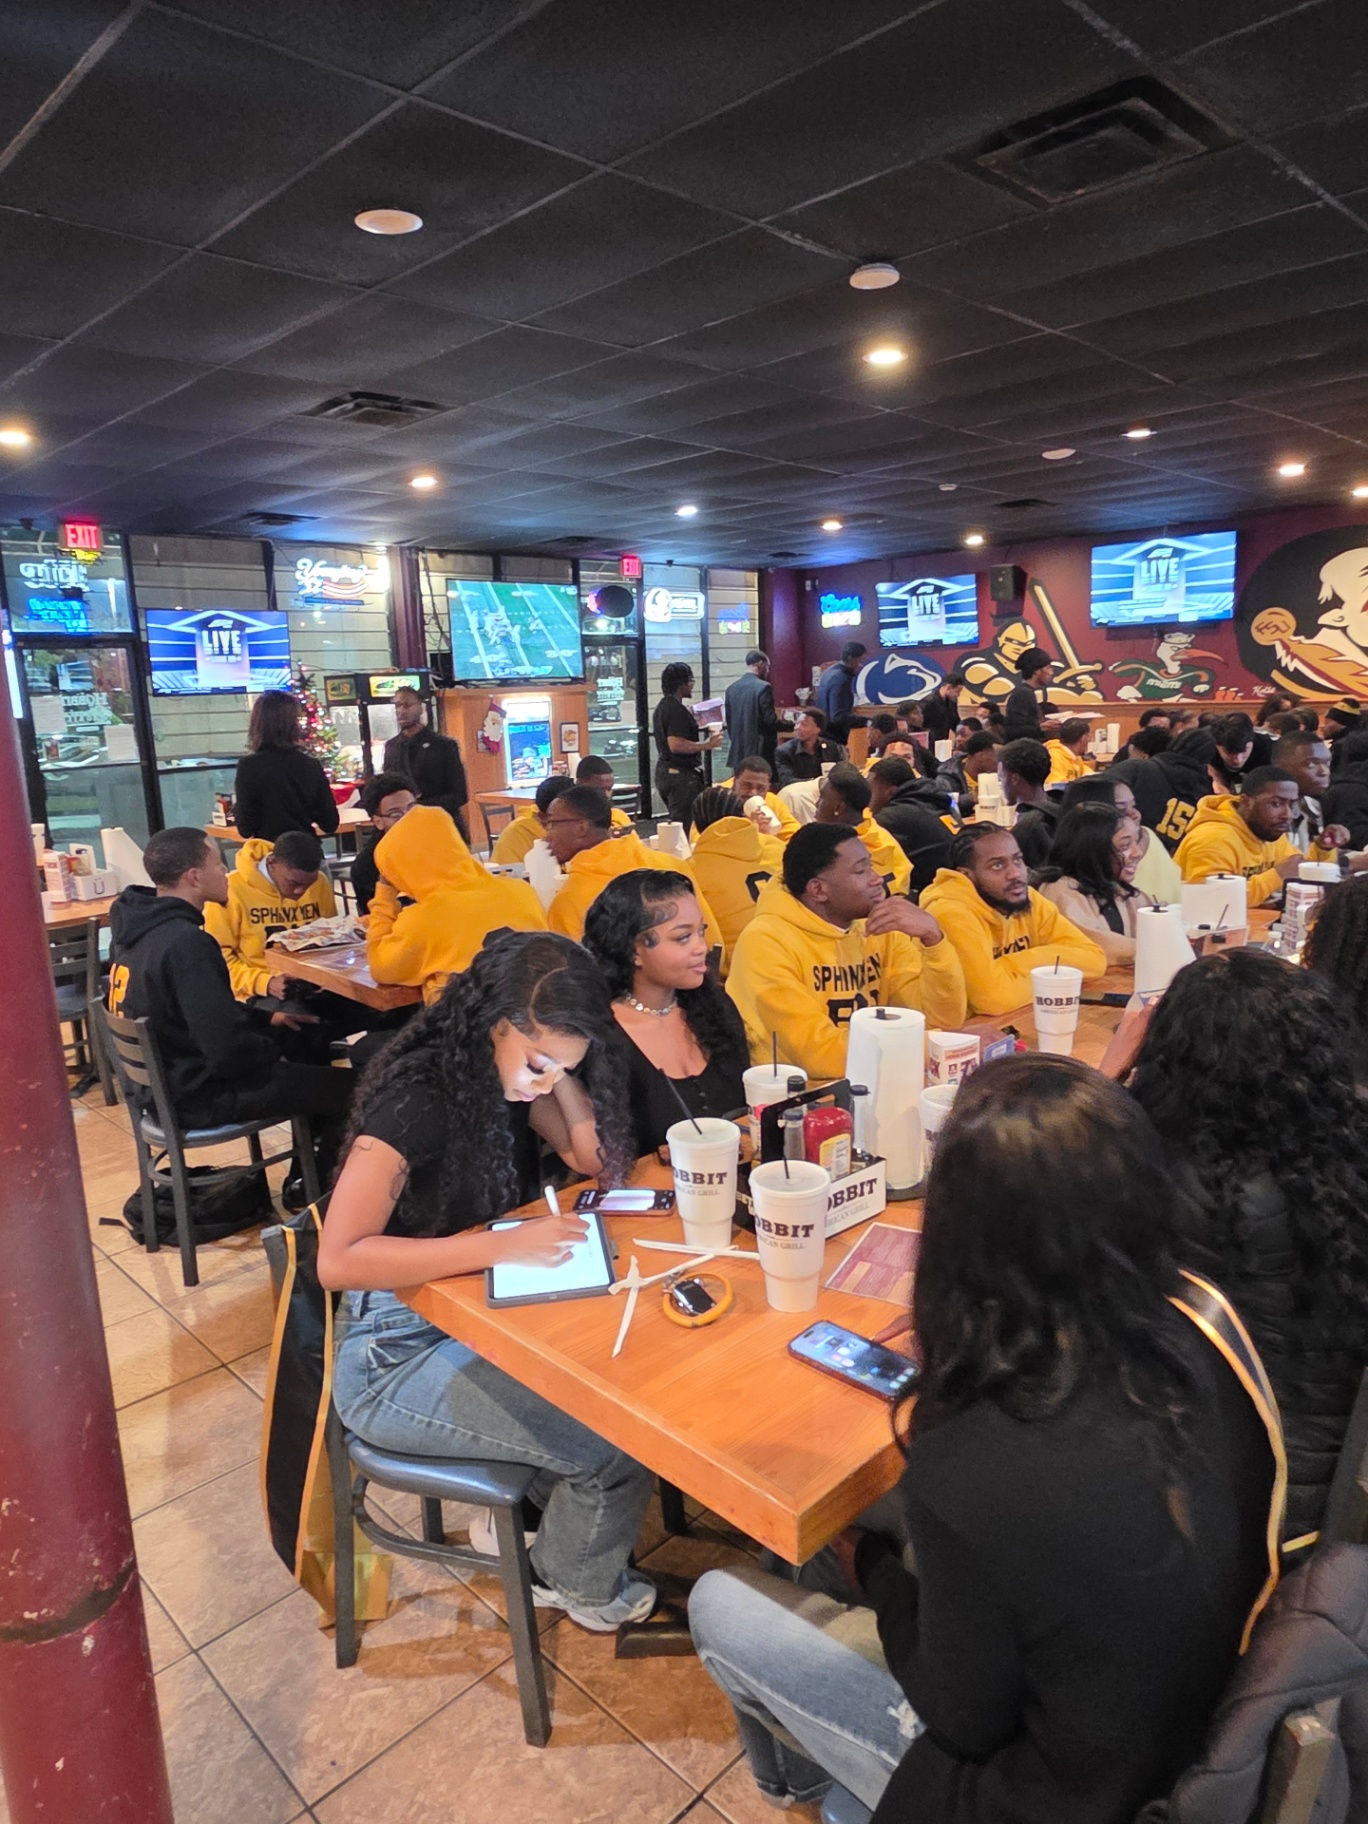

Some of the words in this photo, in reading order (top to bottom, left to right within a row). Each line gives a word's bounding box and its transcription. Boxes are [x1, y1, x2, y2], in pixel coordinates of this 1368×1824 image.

[65, 524, 98, 549] EXIT
[1140, 557, 1180, 584] LIVE
[911, 593, 940, 616] LIVE
[1254, 620, 1291, 635] FSU
[202, 630, 242, 655] LIVE
[1155, 797, 1196, 841] 15
